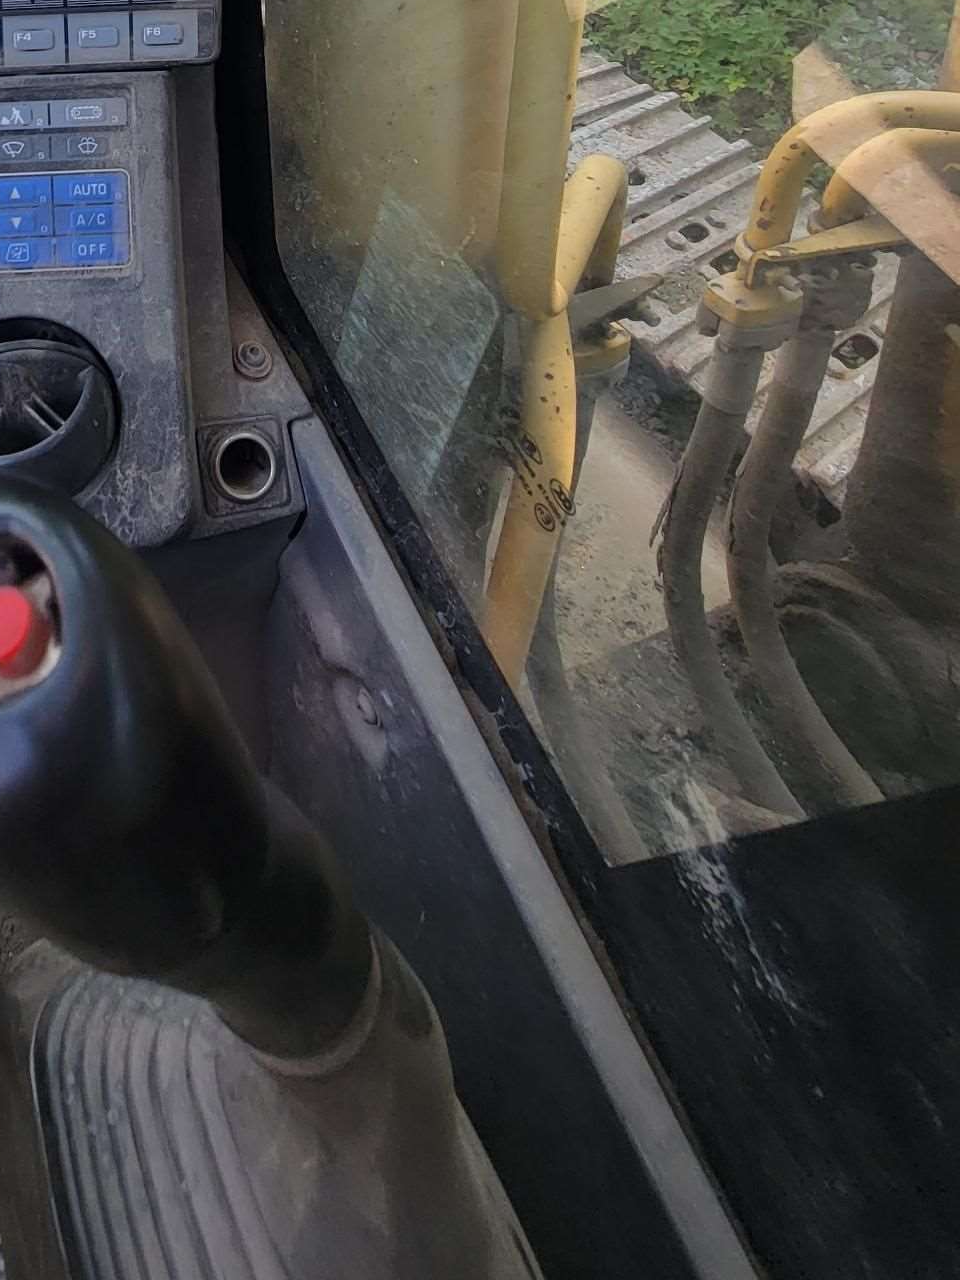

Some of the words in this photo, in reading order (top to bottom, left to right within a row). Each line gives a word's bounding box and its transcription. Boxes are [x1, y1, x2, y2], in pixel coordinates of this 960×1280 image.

[15, 31, 32, 42] F4
[81, 29, 97, 39] F5
[145, 26, 161, 37] F6
[73, 183, 107, 197] AUTO
[75, 213, 106, 226] A/C
[78, 243, 107, 257] OFF
